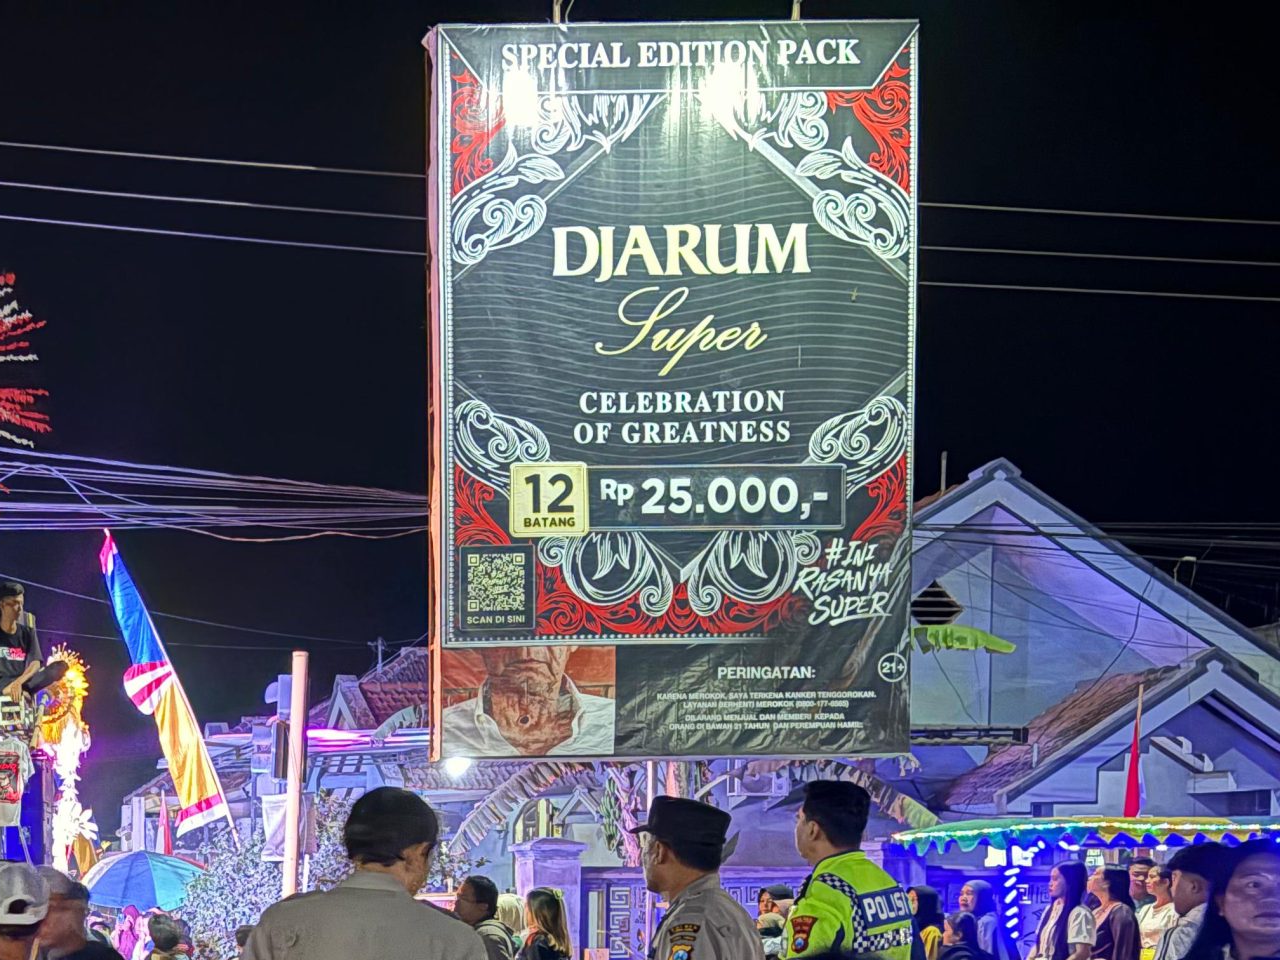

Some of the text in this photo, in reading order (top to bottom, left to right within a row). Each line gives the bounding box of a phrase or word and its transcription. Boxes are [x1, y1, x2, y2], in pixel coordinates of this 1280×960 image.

[501, 39, 860, 69] SPECIAL EDITION PACK
[552, 222, 811, 282] DJARUM
[595, 286, 767, 376] Super
[579, 390, 786, 413] CELEBRATION
[573, 420, 791, 444] OF GREATNESS
[524, 473, 574, 513] 12
[600, 477, 828, 520] Rp 25.000,-
[523, 517, 576, 528] BATANG
[825, 537, 878, 569] #INI
[792, 562, 892, 600] RASANYA
[467, 615, 525, 624] SCAN DI SINI
[808, 591, 892, 626] SUPER
[717, 666, 816, 679] PERINGATAN:
[881, 662, 904, 672] 21+
[750, 691, 785, 699] TERKENA
[756, 700, 795, 708] MEROKOK
[814, 712, 845, 720] KEPADA
[863, 892, 910, 922] POLISI
